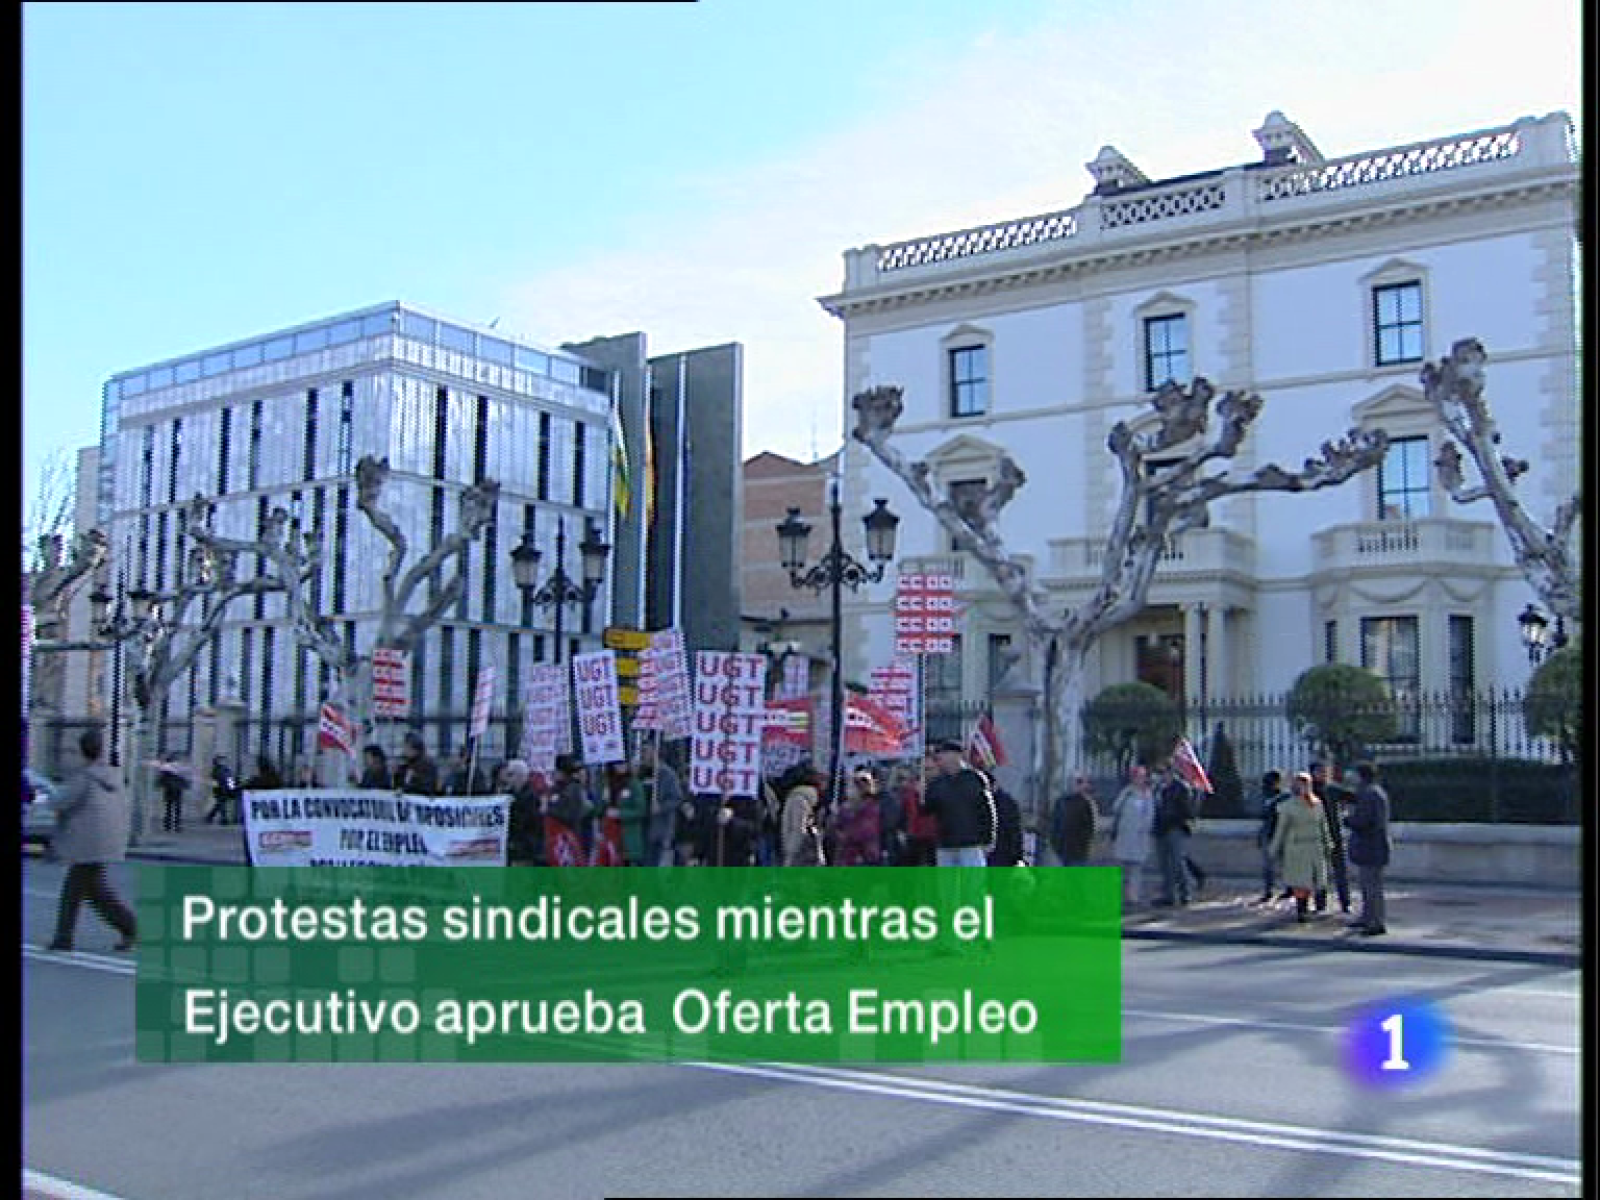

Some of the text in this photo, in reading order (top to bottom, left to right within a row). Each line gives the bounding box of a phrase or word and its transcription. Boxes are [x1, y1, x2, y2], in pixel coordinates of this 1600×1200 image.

[578, 655, 612, 681] UGT
[700, 656, 763, 677] UGT
[580, 684, 614, 710] UGT
[698, 684, 762, 705] UGT
[583, 711, 617, 736] UGT
[697, 711, 761, 734] UGT
[695, 738, 757, 761] UGT
[693, 766, 755, 790] UGT
[282, 797, 302, 819] LA
